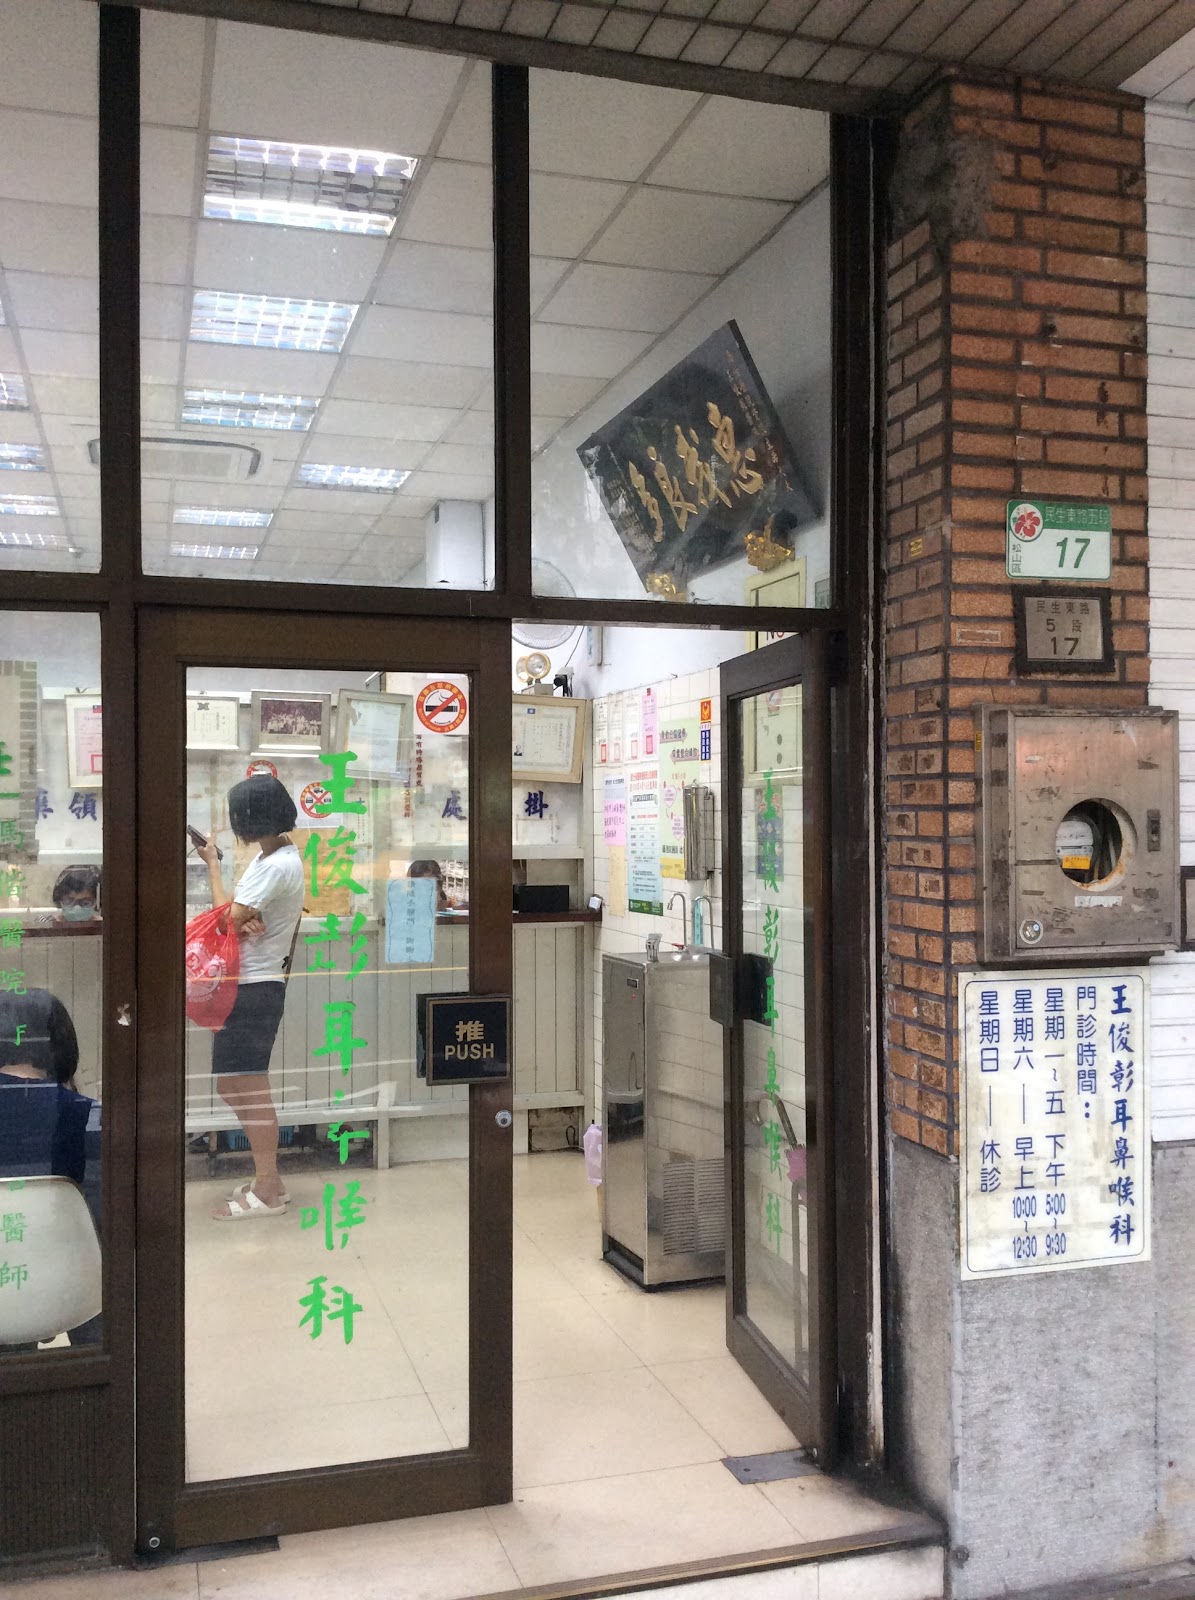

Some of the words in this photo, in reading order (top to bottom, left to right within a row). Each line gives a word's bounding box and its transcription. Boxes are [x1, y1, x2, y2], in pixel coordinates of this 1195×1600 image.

[1045, 506, 1109, 525] 民生東路五段
[1011, 543, 1022, 574] 松山區
[1056, 536, 1090, 569] 17
[1036, 600, 1090, 616] 民生東路
[1045, 618, 1056, 633] 5
[1071, 619, 1083, 634] 段
[1050, 636, 1080, 656] 17
[524, 790, 549, 819] 掛
[455, 1020, 485, 1042] 推
[444, 1042, 495, 1061] PUSH
[1108, 983, 1136, 1247] 王俊彰耳鼻喉科
